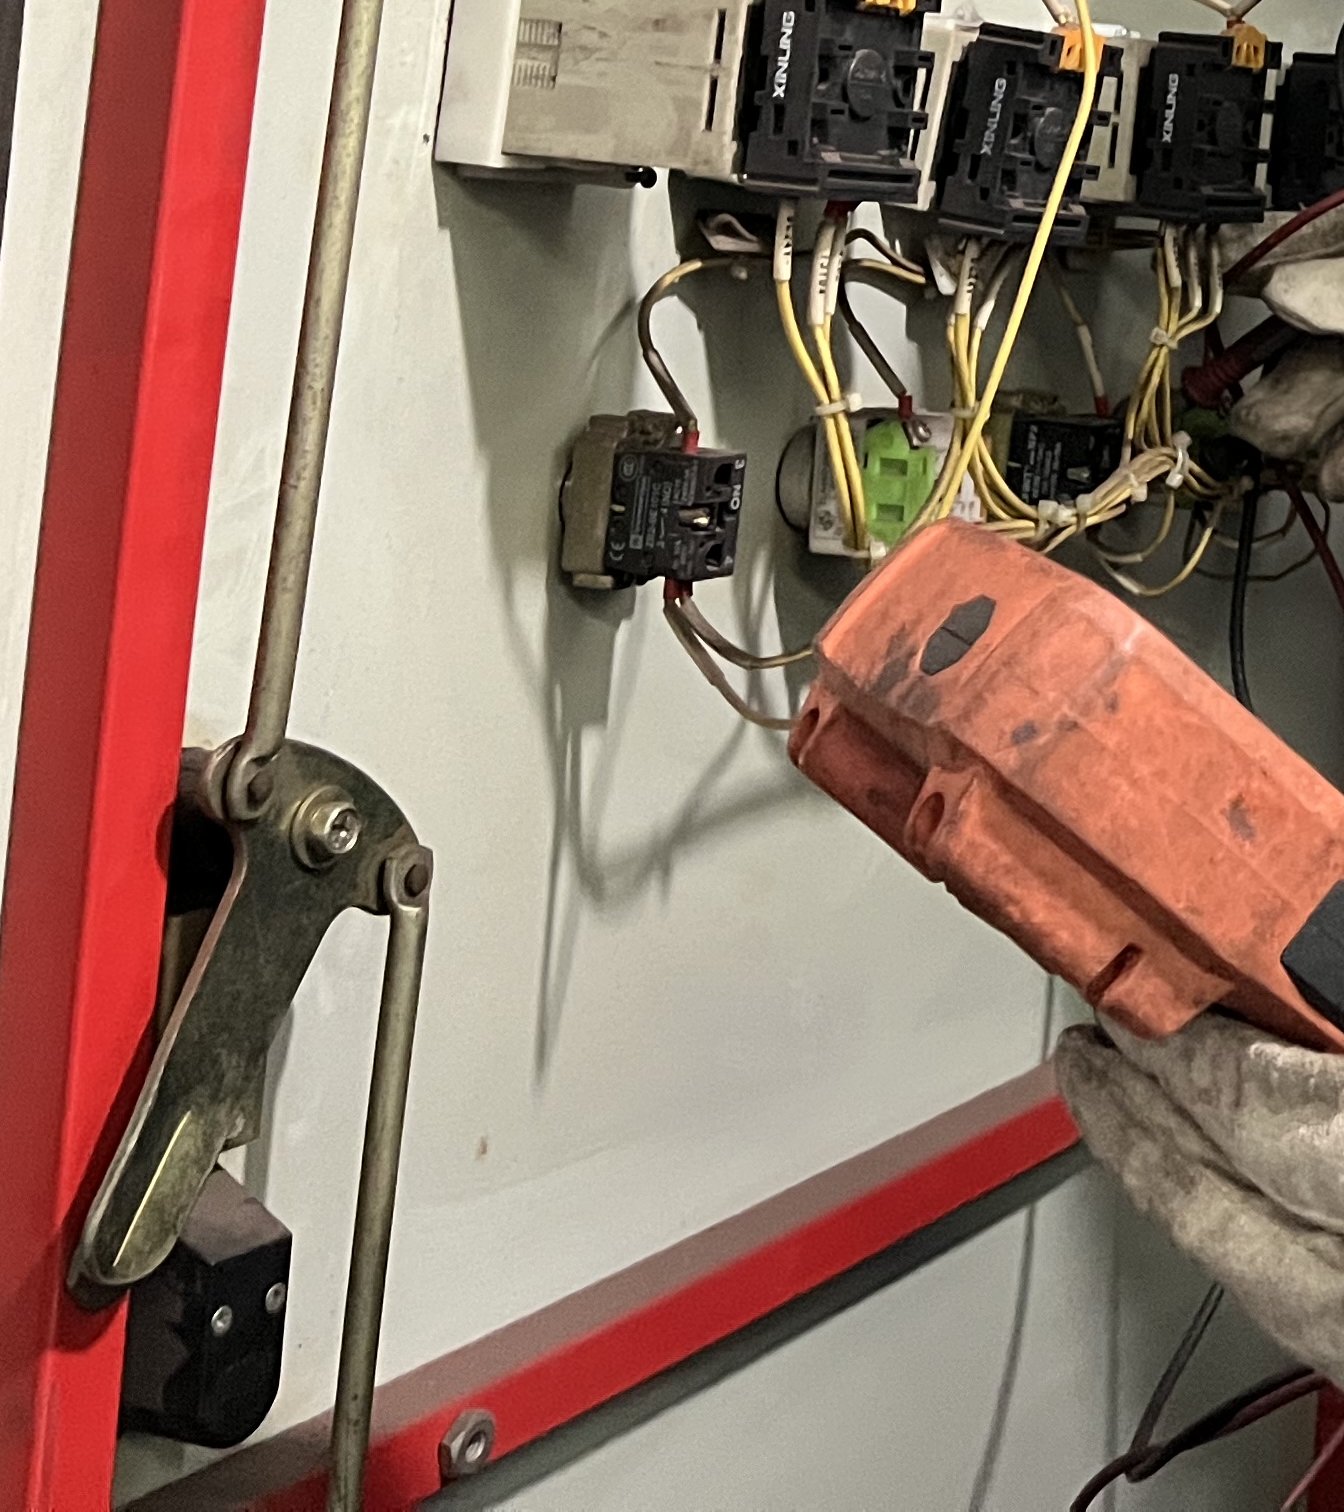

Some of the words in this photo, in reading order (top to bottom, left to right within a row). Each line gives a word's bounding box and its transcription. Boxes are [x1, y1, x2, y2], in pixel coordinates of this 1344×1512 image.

[772, 11, 795, 98] XINLING
[980, 77, 1007, 156] XINLING
[1162, 73, 1179, 143] XINLING
[730, 484, 742, 510] NO
